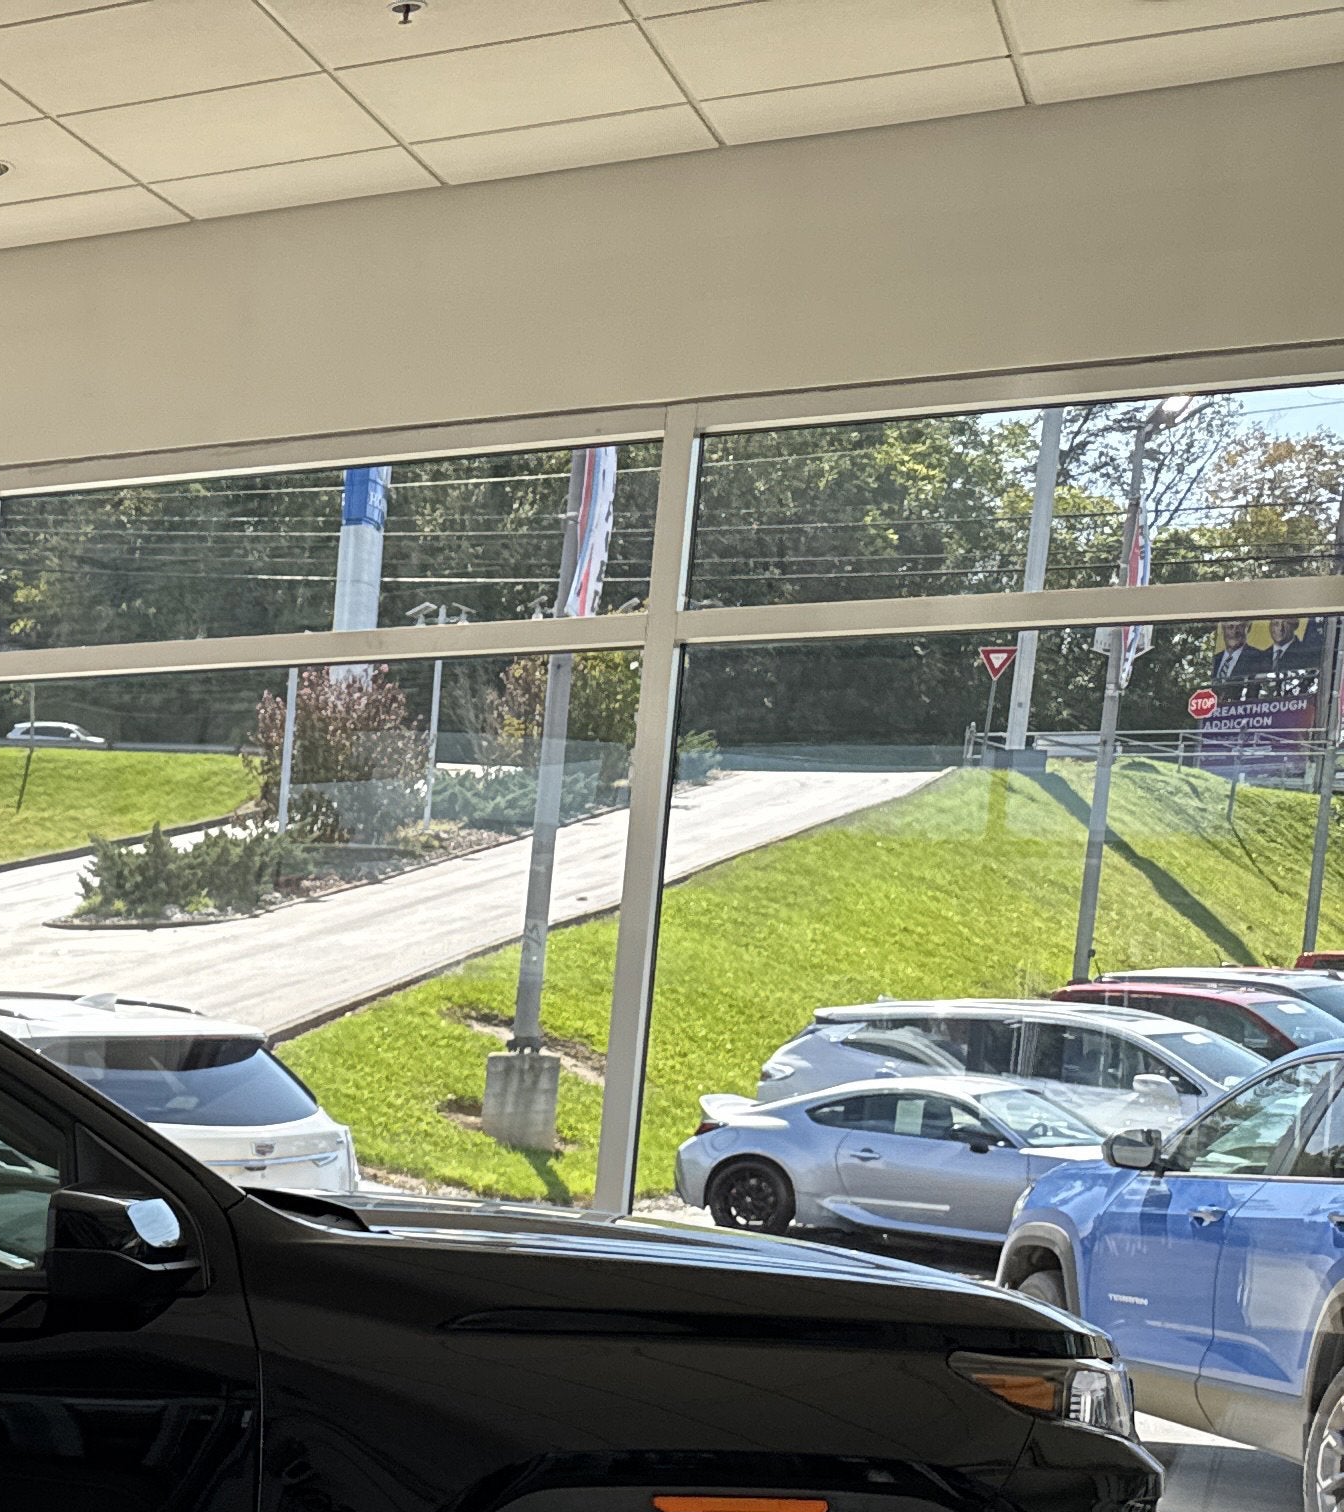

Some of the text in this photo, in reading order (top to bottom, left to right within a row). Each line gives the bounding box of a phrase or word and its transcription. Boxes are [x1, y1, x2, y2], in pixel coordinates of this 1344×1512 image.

[1191, 698, 1215, 711] STOP
[1212, 700, 1308, 717] REAKTHROUGH
[1204, 716, 1272, 730] ADDICTION
